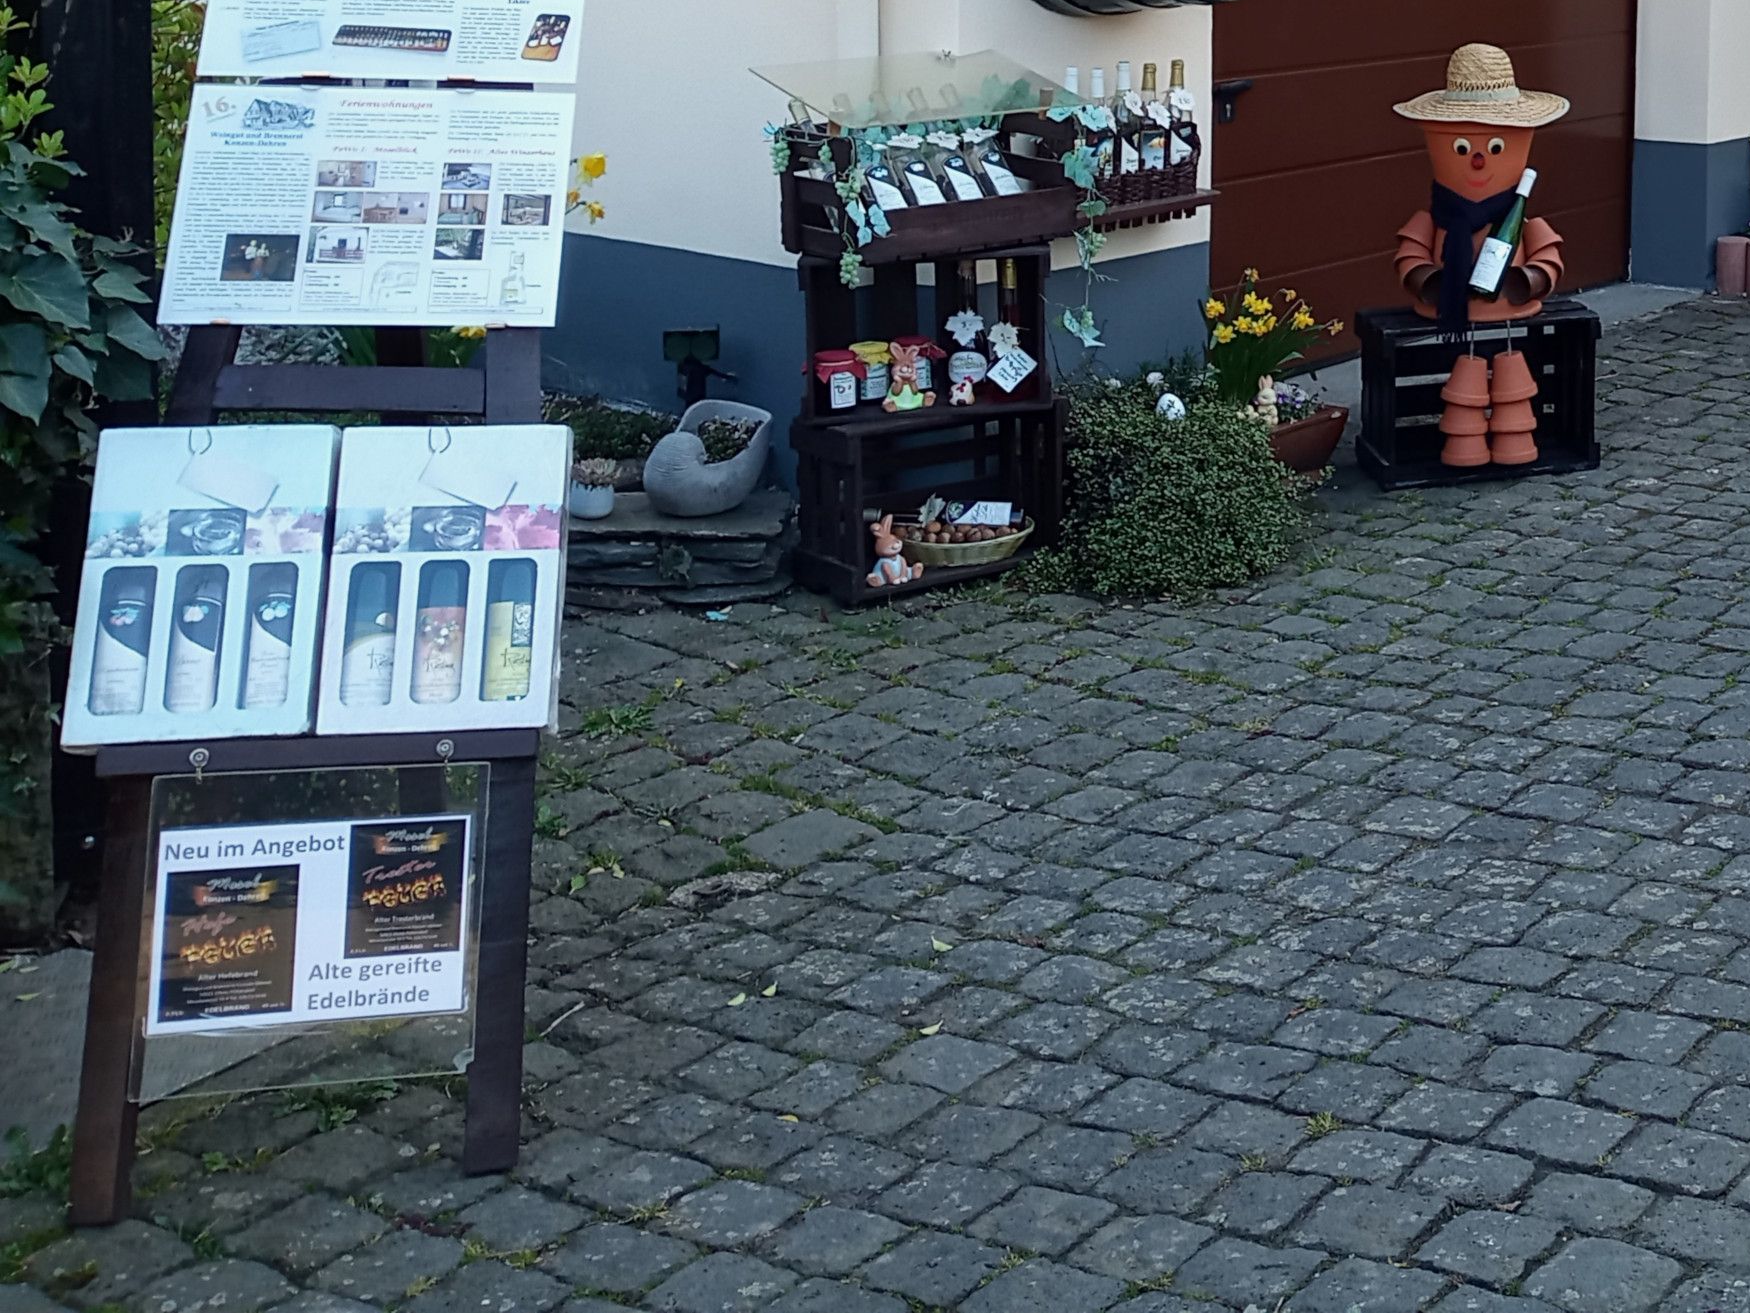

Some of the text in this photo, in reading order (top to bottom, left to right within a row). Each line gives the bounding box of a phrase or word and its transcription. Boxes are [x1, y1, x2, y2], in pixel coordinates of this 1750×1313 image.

[164, 835, 346, 861] Neu im Angebot
[308, 957, 442, 981] Alte gereifte
[307, 986, 430, 1010] Edelbrände
